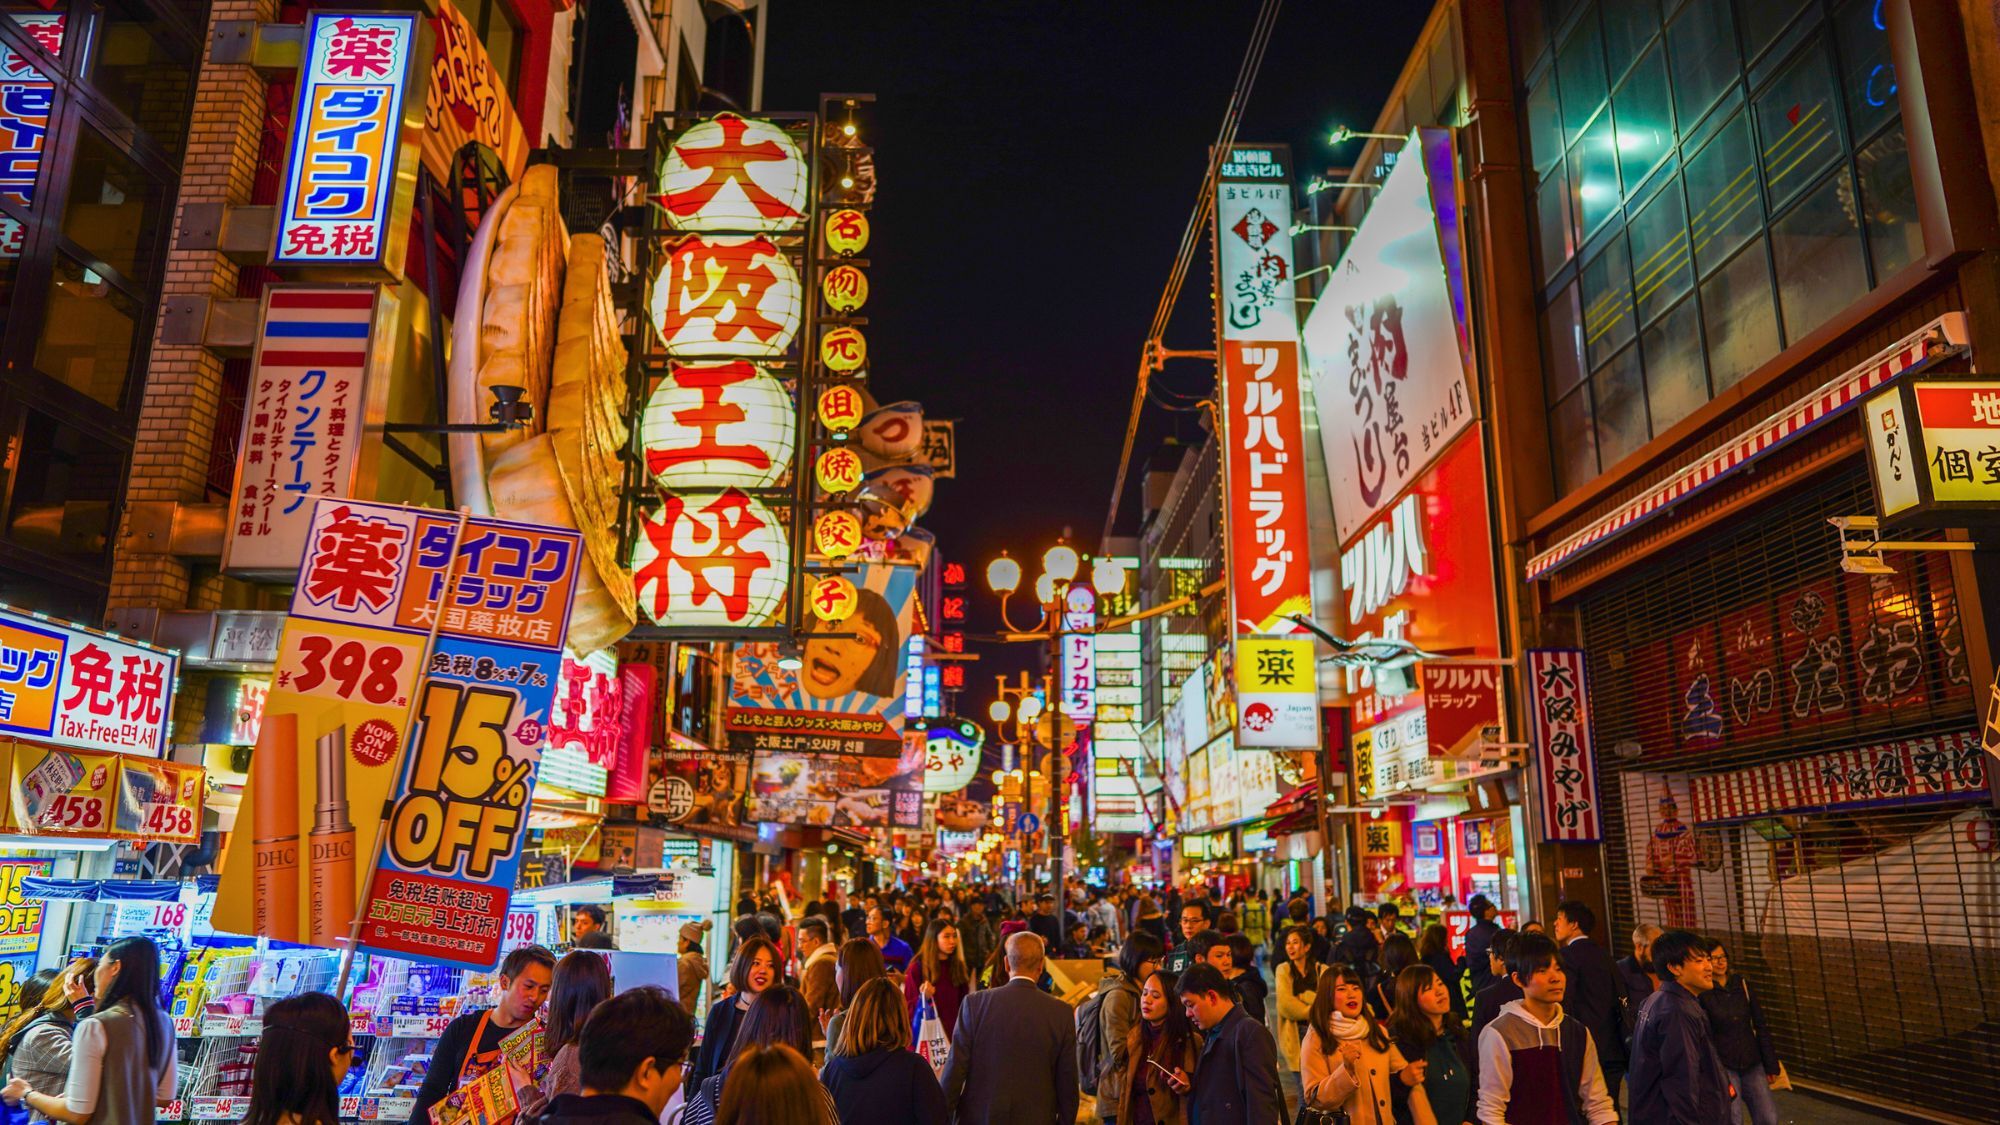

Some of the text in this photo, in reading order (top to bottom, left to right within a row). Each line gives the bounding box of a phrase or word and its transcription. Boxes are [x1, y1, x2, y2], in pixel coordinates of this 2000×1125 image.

[324, 20, 400, 80] 薬
[304, 88, 385, 217] ダイコク
[284, 223, 375, 256] 免税
[635, 113, 809, 621] 大阪王将
[283, 370, 326, 515] クンテープ
[321, 380, 349, 498] タイ料理とタイス
[1886, 425, 1902, 482] がんこ
[1241, 347, 1293, 597] ツルハドラッグ
[307, 517, 404, 609] 薬
[417, 524, 572, 584] ダイコク
[1341, 494, 1427, 625] ツルハ
[0, 643, 58, 689] ッグ
[63, 642, 165, 725] 免税
[1257, 649, 1294, 685] 薬
[1426, 669, 1494, 689] ツルハ
[733, 682, 797, 700] ショップ
[1286, 705, 1312, 713] Japan
[1428, 694, 1482, 709] ドラッグ
[60, 713, 157, 750] Tax-Free 면세
[364, 722, 395, 740] NOW
[364, 735, 384, 749] ON
[409, 679, 531, 808] 15%
[1541, 663, 1590, 828] 大阪みやげ
[355, 741, 389, 762] SALE!
[312, 839, 351, 860] DHC
[388, 795, 519, 878] OFF
[1367, 826, 1389, 853] 薬
[257, 847, 296, 868] DHC
[313, 868, 323, 890] LIP
[388, 879, 492, 913] 免税结账超过
[153, 903, 185, 926] 168
[257, 901, 267, 937] CREA
[507, 912, 535, 940] 398
[426, 1018, 450, 1031] 548
[216, 1099, 232, 1113] 648
